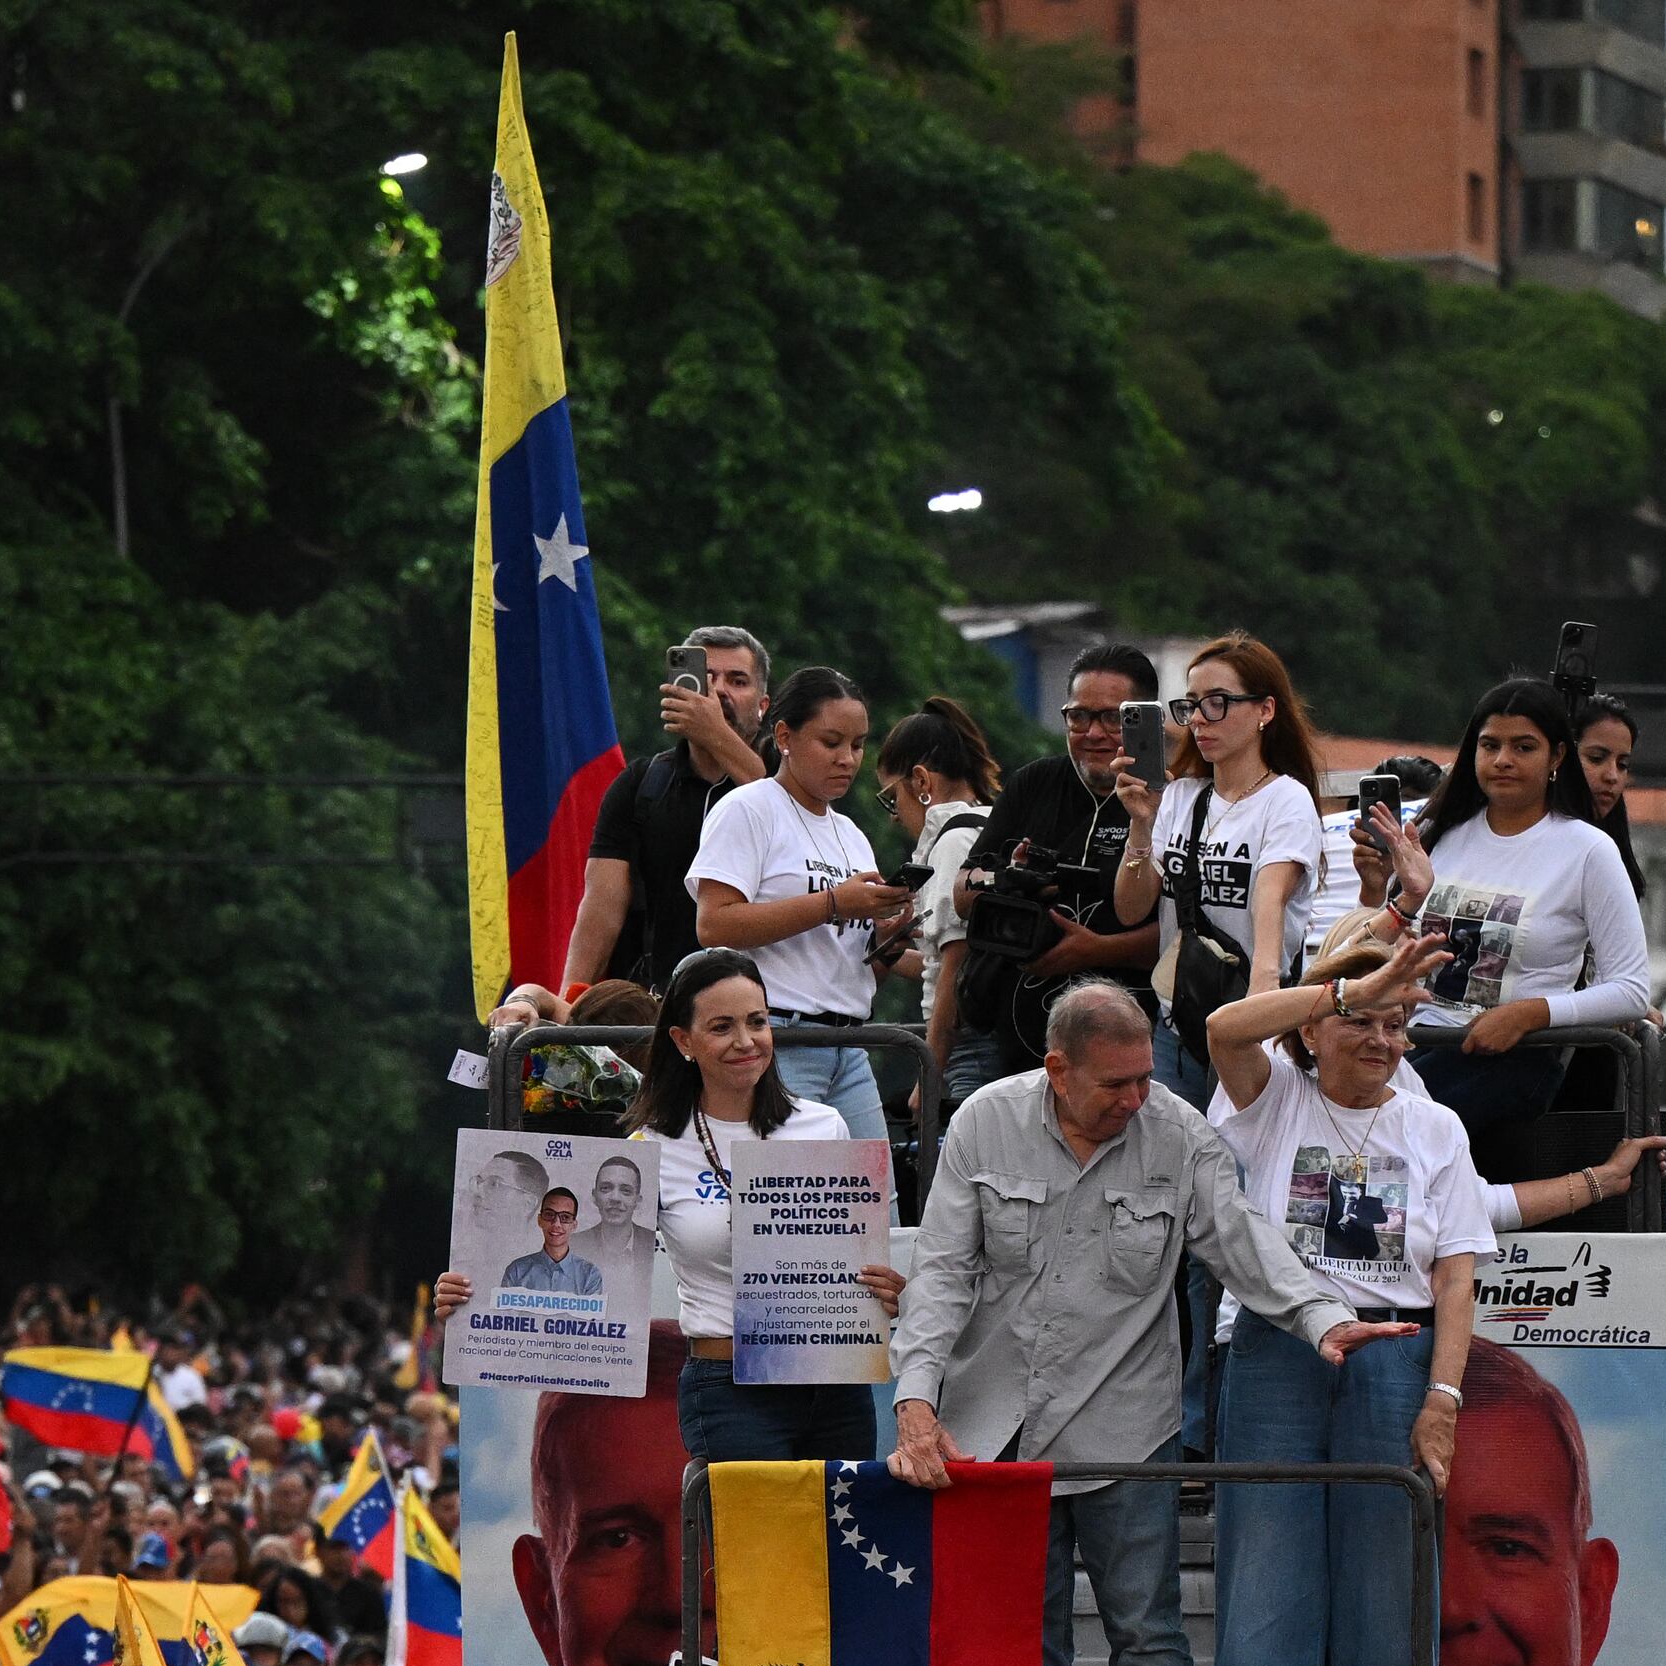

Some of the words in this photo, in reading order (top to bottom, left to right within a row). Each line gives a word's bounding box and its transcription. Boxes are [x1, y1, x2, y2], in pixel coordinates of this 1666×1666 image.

[1234, 843, 1251, 859] A
[1168, 856, 1235, 882] GIEL
[1163, 875, 1246, 903] GÁLEZ
[548, 1140, 571, 1149] CON
[545, 1149, 573, 1158] VZLA
[697, 1169, 731, 1184] CO
[749, 1176, 827, 1190] ¡LIBERTAD
[829, 1176, 870, 1188] PARA
[695, 1185, 731, 1199] VZ
[739, 1192, 791, 1204] TODOS
[793, 1192, 821, 1204] LOS
[824, 1192, 881, 1203] PRESOS
[771, 1205, 849, 1219] POLÍTICOS
[753, 1224, 772, 1235] EN
[775, 1223, 866, 1235] VENEZUELA!
[1509, 1244, 1528, 1264] la
[775, 1260, 798, 1270] Son
[801, 1260, 828, 1270] más
[831, 1260, 847, 1270] de
[1375, 1262, 1412, 1273] TOUR
[743, 1273, 768, 1284] 270
[771, 1273, 859, 1285] VENEZOLAN
[1382, 1273, 1401, 1283] 2024
[737, 1289, 820, 1301] secuestrados,
[496, 1294, 603, 1312] ¡DESAPARECIDO!
[765, 1306, 772, 1316] y
[775, 1304, 858, 1314] encarcelados
[470, 1313, 538, 1333] GABRIEL
[544, 1318, 627, 1339] GONZÁLEZ
[753, 1319, 832, 1331] injustamente
[836, 1320, 856, 1331] por
[859, 1319, 870, 1329] el
[741, 1330, 807, 1345] RÉGIMEN
[810, 1334, 883, 1345] CRIMINAL
[1513, 1324, 1651, 1344] Democrática
[468, 1335, 516, 1347] Periodista
[518, 1340, 524, 1348] y
[526, 1339, 571, 1349] miembro
[574, 1341, 590, 1351] del
[591, 1344, 626, 1355] equipo
[459, 1347, 501, 1357] nacional
[504, 1349, 517, 1358] de
[519, 1350, 602, 1364] Comunicaciones
[604, 1355, 633, 1366] Vente
